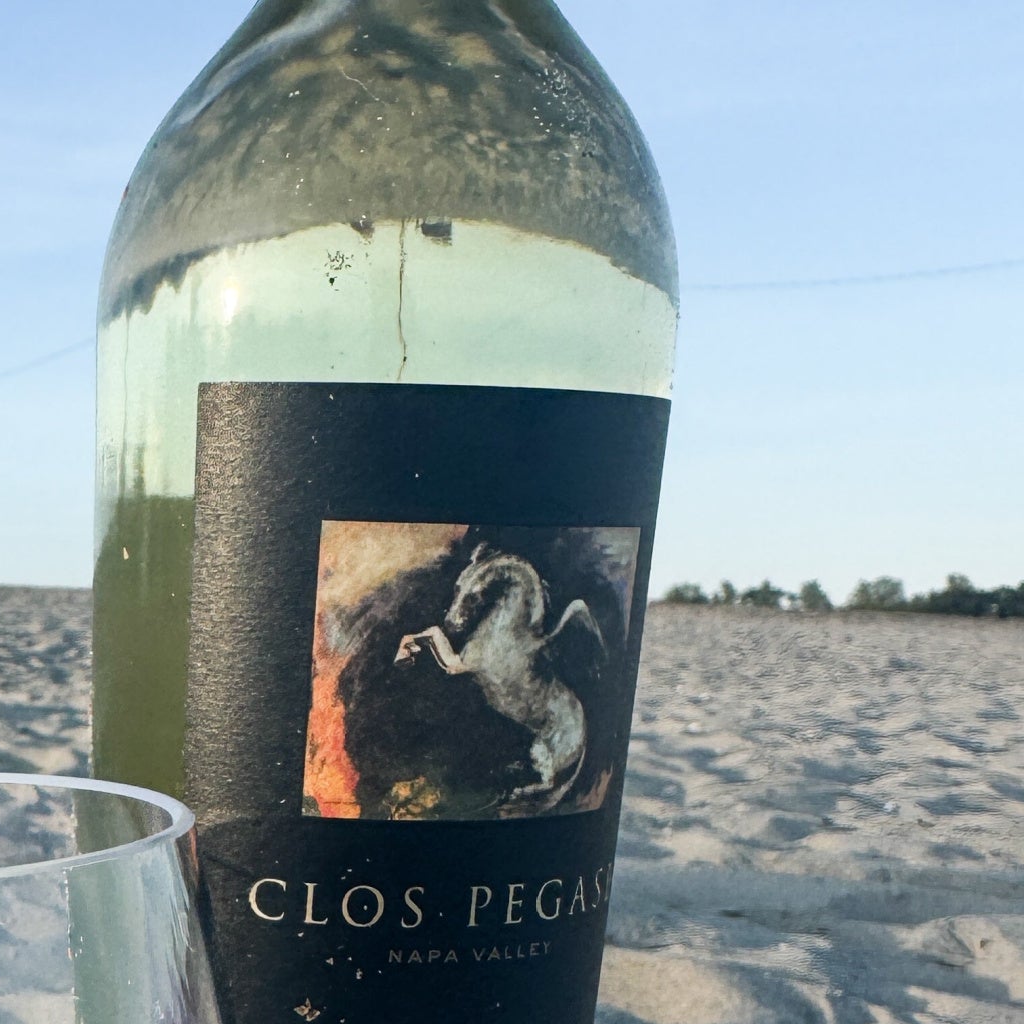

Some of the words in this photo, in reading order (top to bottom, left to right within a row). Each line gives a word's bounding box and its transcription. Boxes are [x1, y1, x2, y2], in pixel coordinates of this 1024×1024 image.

[248, 877, 425, 928] CLOS
[388, 949, 458, 964] NAPA
[472, 940, 552, 962] VALLEY
